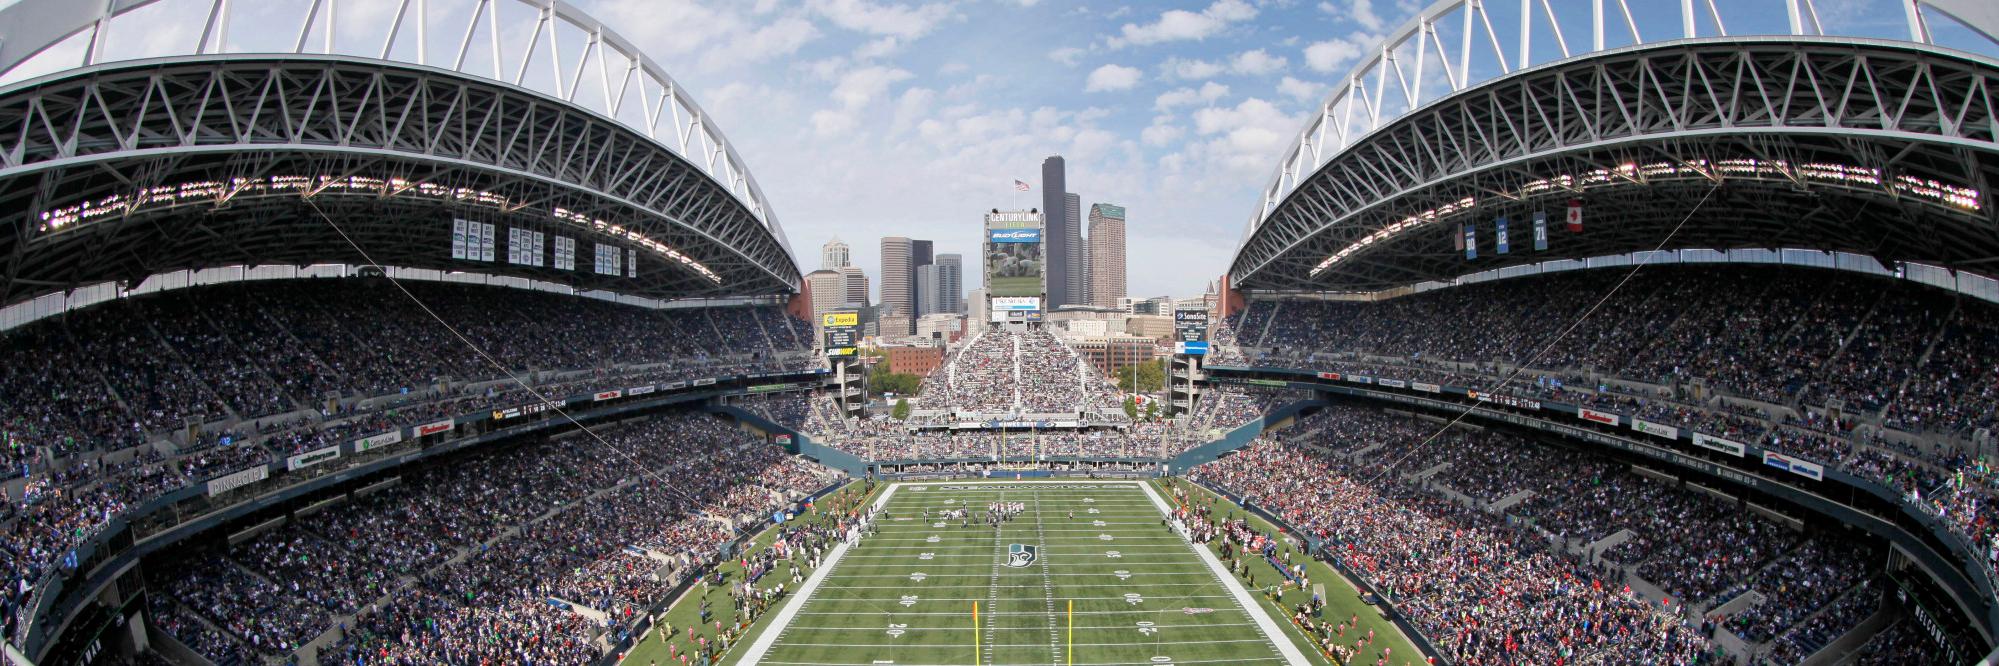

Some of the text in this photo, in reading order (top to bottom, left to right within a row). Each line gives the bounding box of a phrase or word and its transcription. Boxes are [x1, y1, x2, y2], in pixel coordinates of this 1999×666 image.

[991, 213, 1038, 222] CENTURYLINK
[1498, 232, 1506, 244] 12
[1535, 227, 1545, 240] 71
[827, 347, 857, 356] SUBWAY
[213, 469, 259, 494] PINNACLE
[1915, 604, 1946, 649] WELCOME
